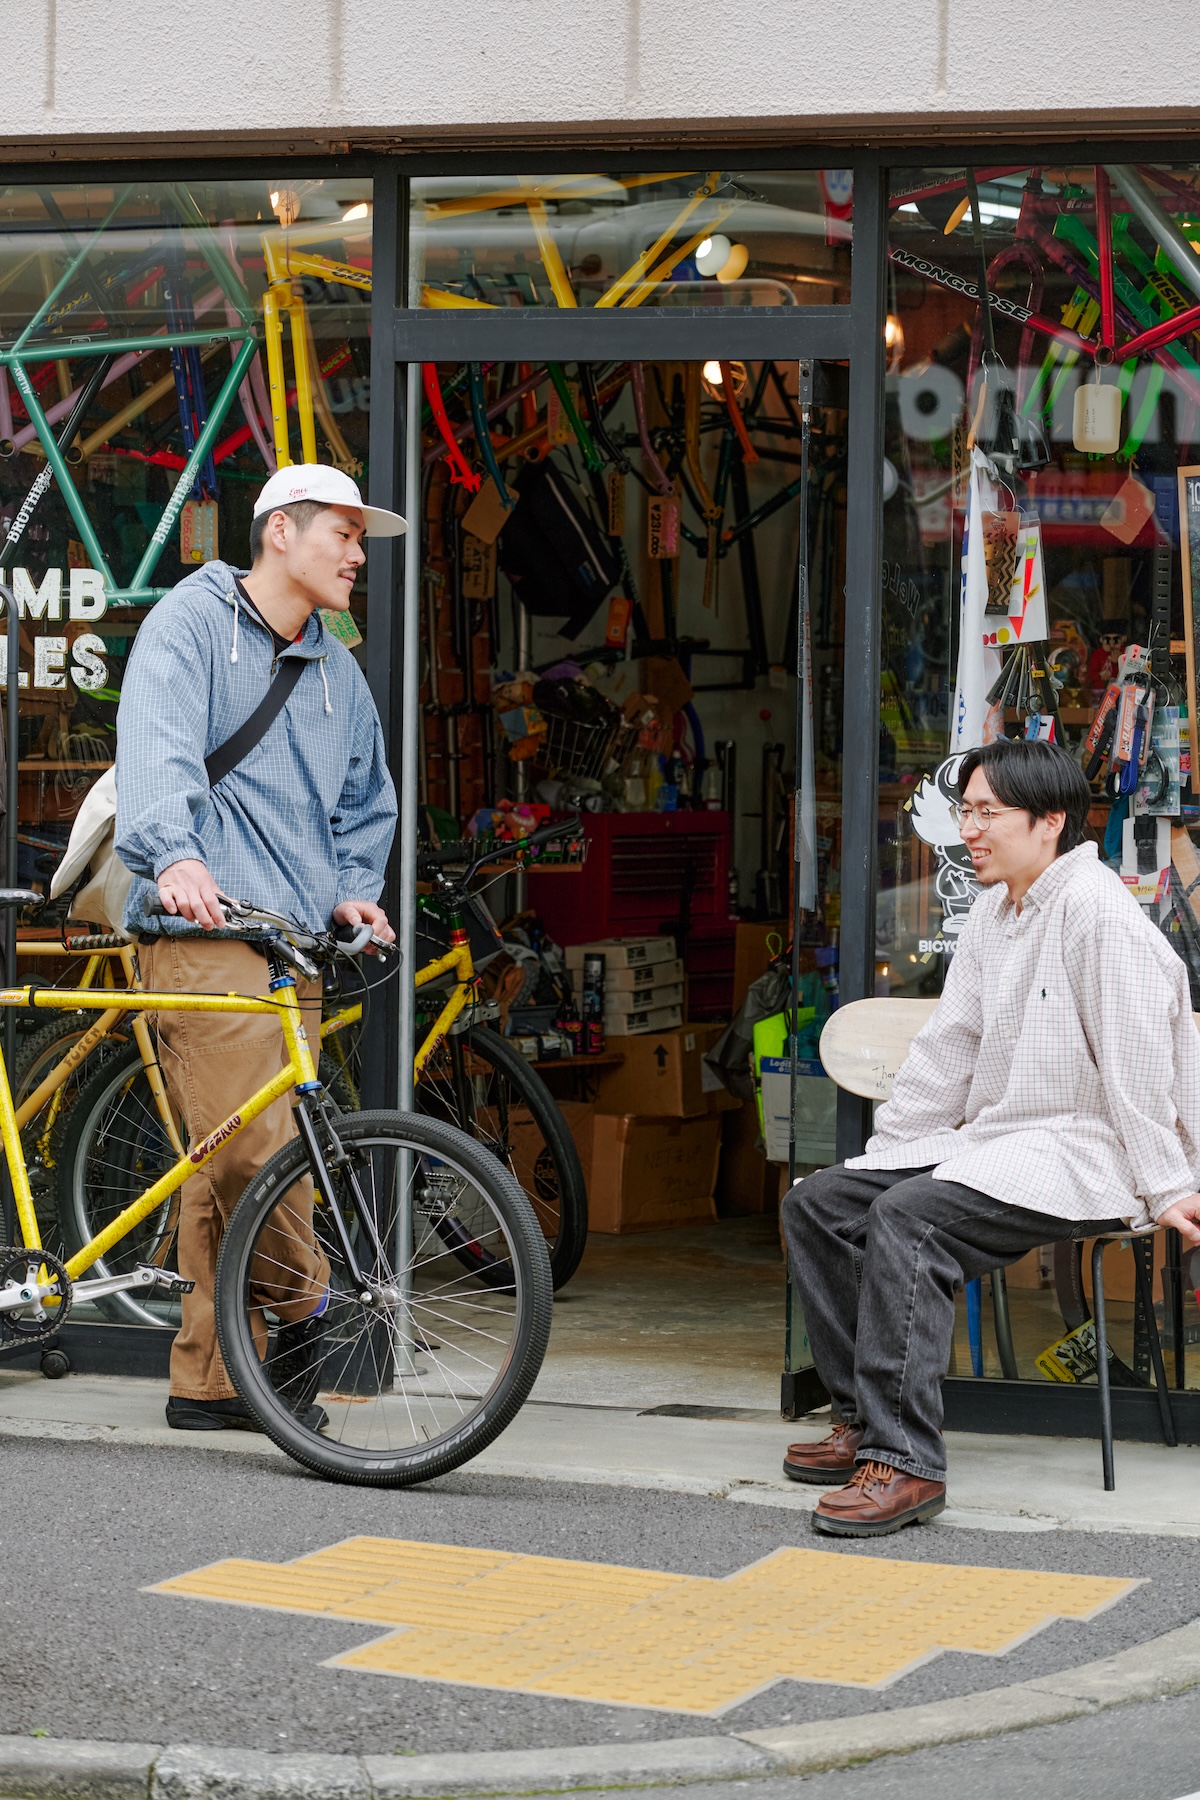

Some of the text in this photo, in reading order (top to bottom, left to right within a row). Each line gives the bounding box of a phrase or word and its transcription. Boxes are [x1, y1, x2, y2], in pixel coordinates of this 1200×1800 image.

[190, 1115, 242, 1163] WIZARD
[1071, 1242, 1079, 1300] CONTINENTA
[363, 1410, 487, 1470] SCHWALBE
